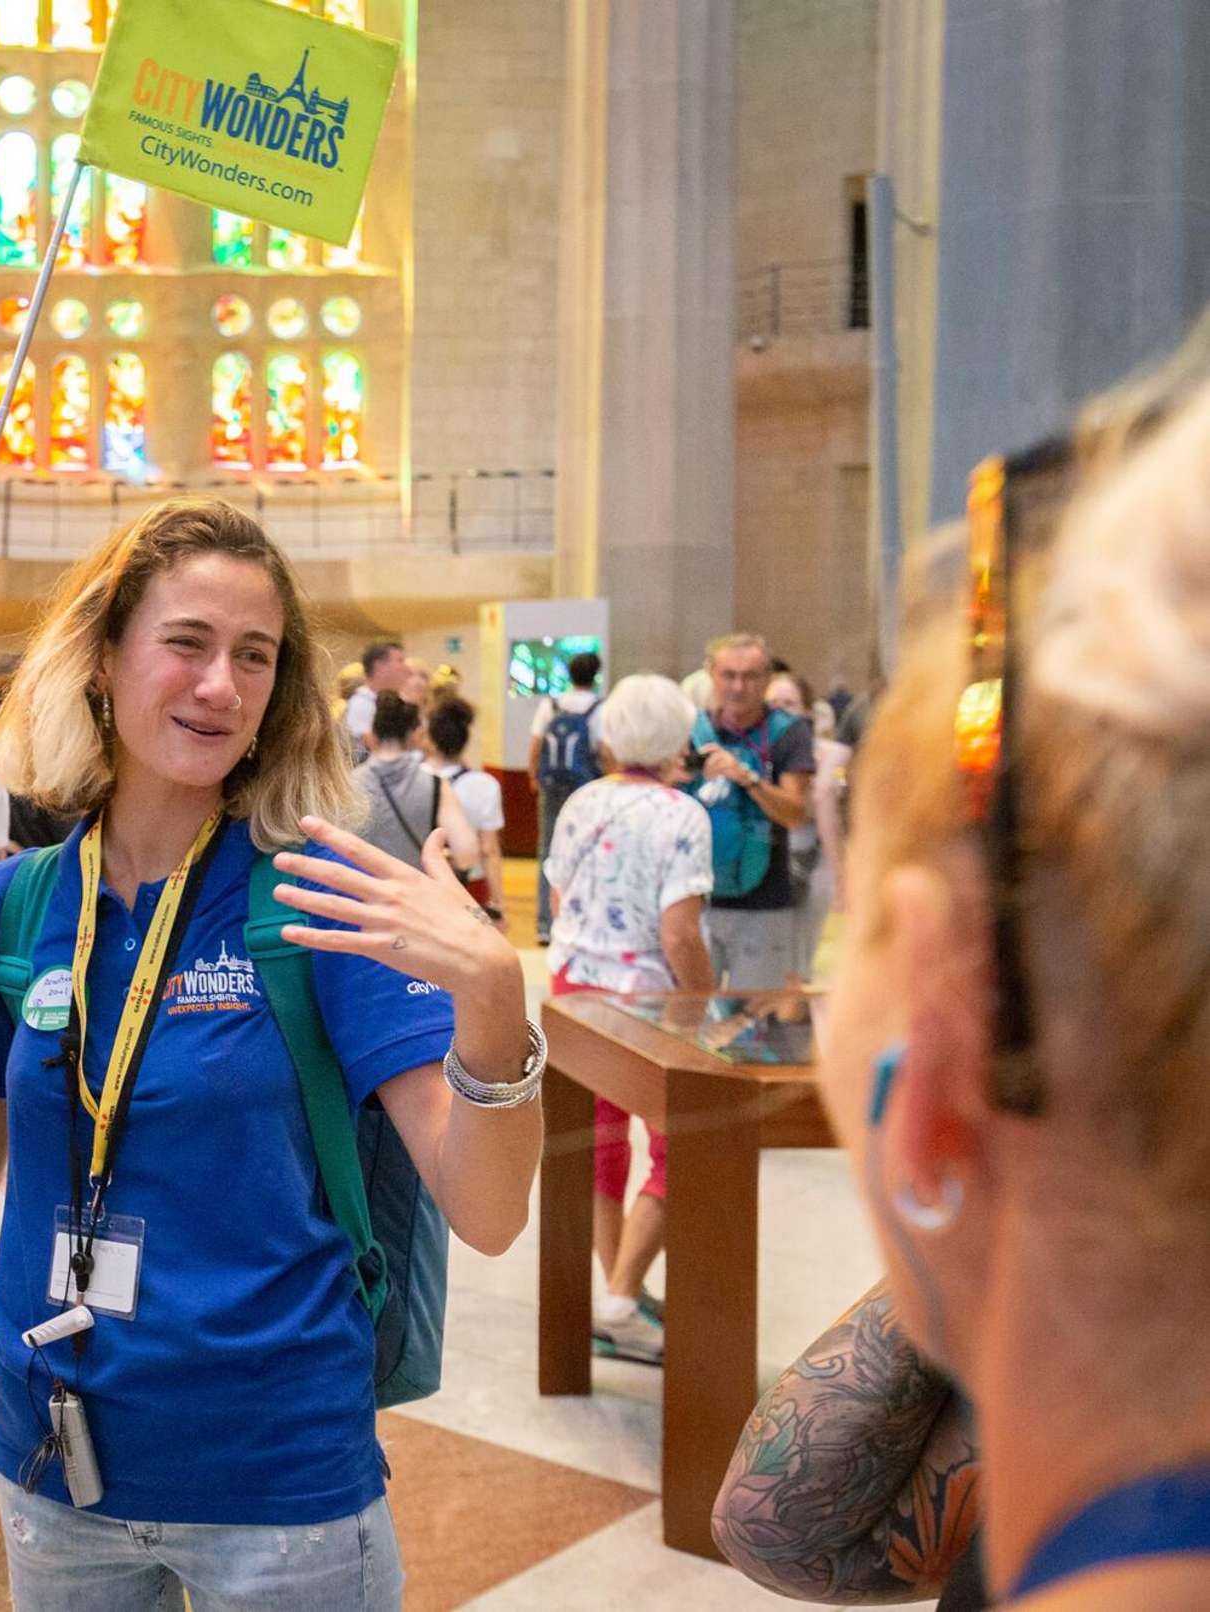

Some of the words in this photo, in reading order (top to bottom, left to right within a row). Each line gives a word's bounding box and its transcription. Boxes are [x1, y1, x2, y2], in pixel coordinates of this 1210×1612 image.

[128, 110, 174, 134] FAMOUS
[140, 135, 314, 207] CityWonders.com
[177, 994, 208, 1004] FAMOUS
